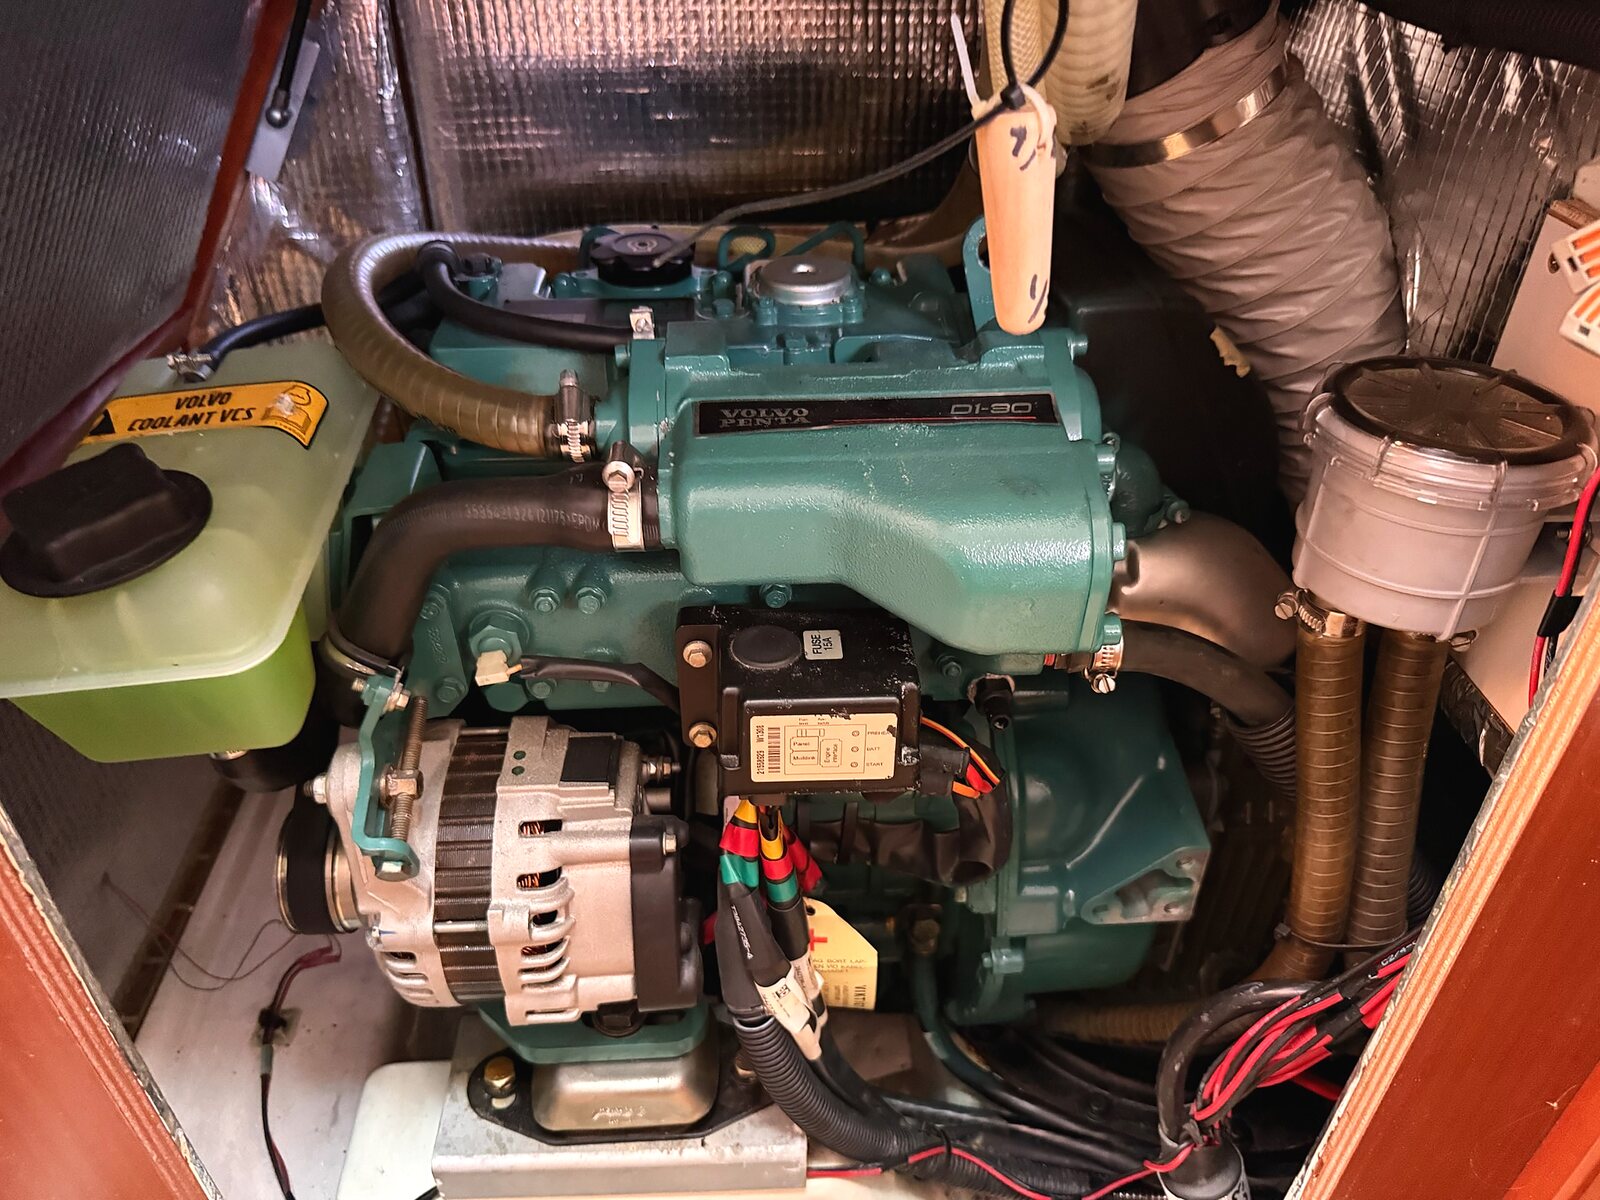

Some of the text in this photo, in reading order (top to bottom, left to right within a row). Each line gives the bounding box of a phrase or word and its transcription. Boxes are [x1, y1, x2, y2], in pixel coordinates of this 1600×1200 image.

[174, 391, 233, 410] VOLVO
[719, 407, 810, 418] VOLVO
[950, 402, 1033, 414] D1-30
[127, 407, 257, 432] COOLANT VCS
[719, 416, 811, 428] PENTA
[811, 634, 822, 654] FUSE
[822, 636, 833, 650] 15A
